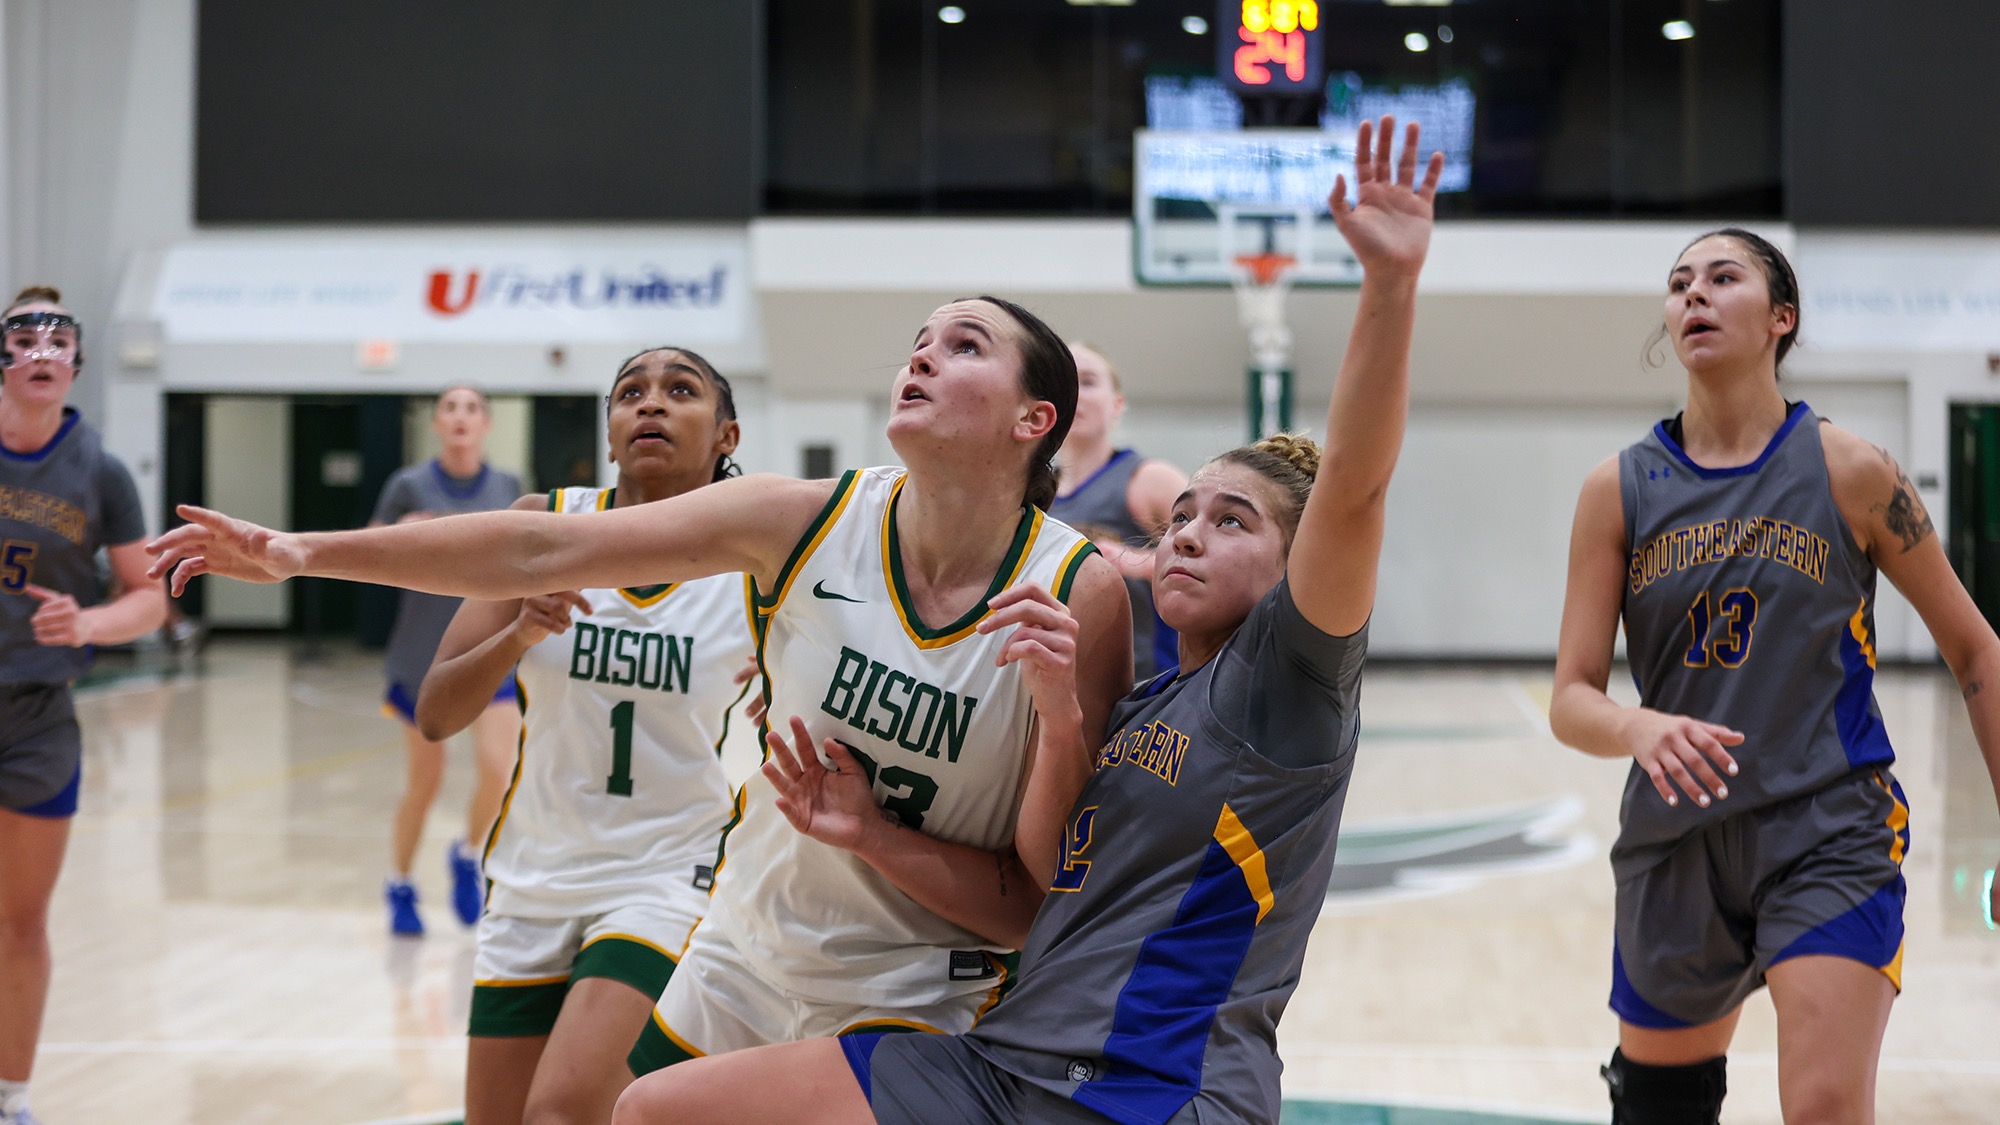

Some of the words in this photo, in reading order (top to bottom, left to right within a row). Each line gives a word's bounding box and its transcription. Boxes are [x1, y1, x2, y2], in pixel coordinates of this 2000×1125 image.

[1234, 27, 1306, 85] 24
[1630, 516, 1829, 595] SOUTHEASTERN
[569, 622, 693, 694] BISON
[1684, 586, 1758, 668] 13
[821, 646, 978, 763] BISON
[606, 701, 635, 797] 1
